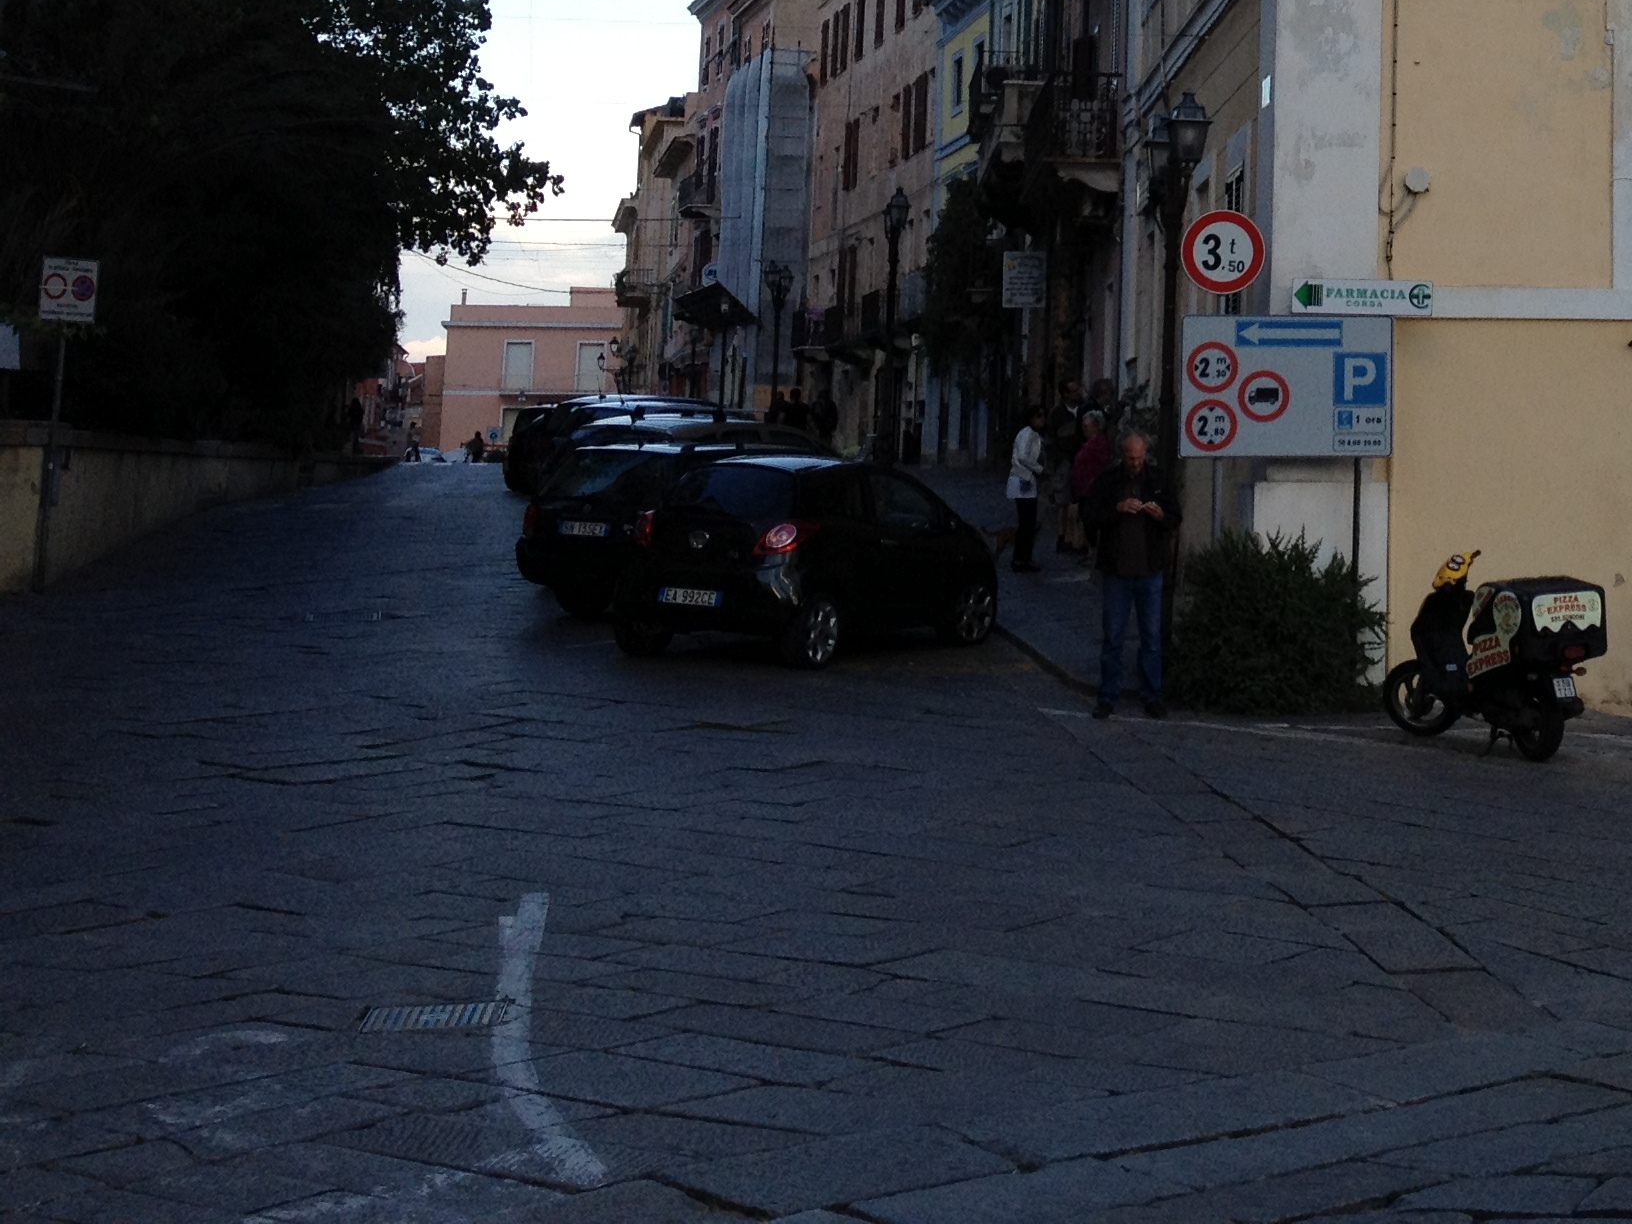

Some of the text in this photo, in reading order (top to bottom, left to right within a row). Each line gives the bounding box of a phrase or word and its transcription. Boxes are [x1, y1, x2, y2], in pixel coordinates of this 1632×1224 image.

[1229, 238, 1236, 255] t
[1326, 287, 1407, 300] FARMACIA
[1343, 357, 1377, 401] P
[1355, 414, 1382, 424] 1 ora
[1553, 595, 1580, 605] PIZZA
[1547, 604, 1587, 615] EXPRESS
[1473, 636, 1502, 653] PIZZA
[1467, 650, 1510, 675] EXPRESS
